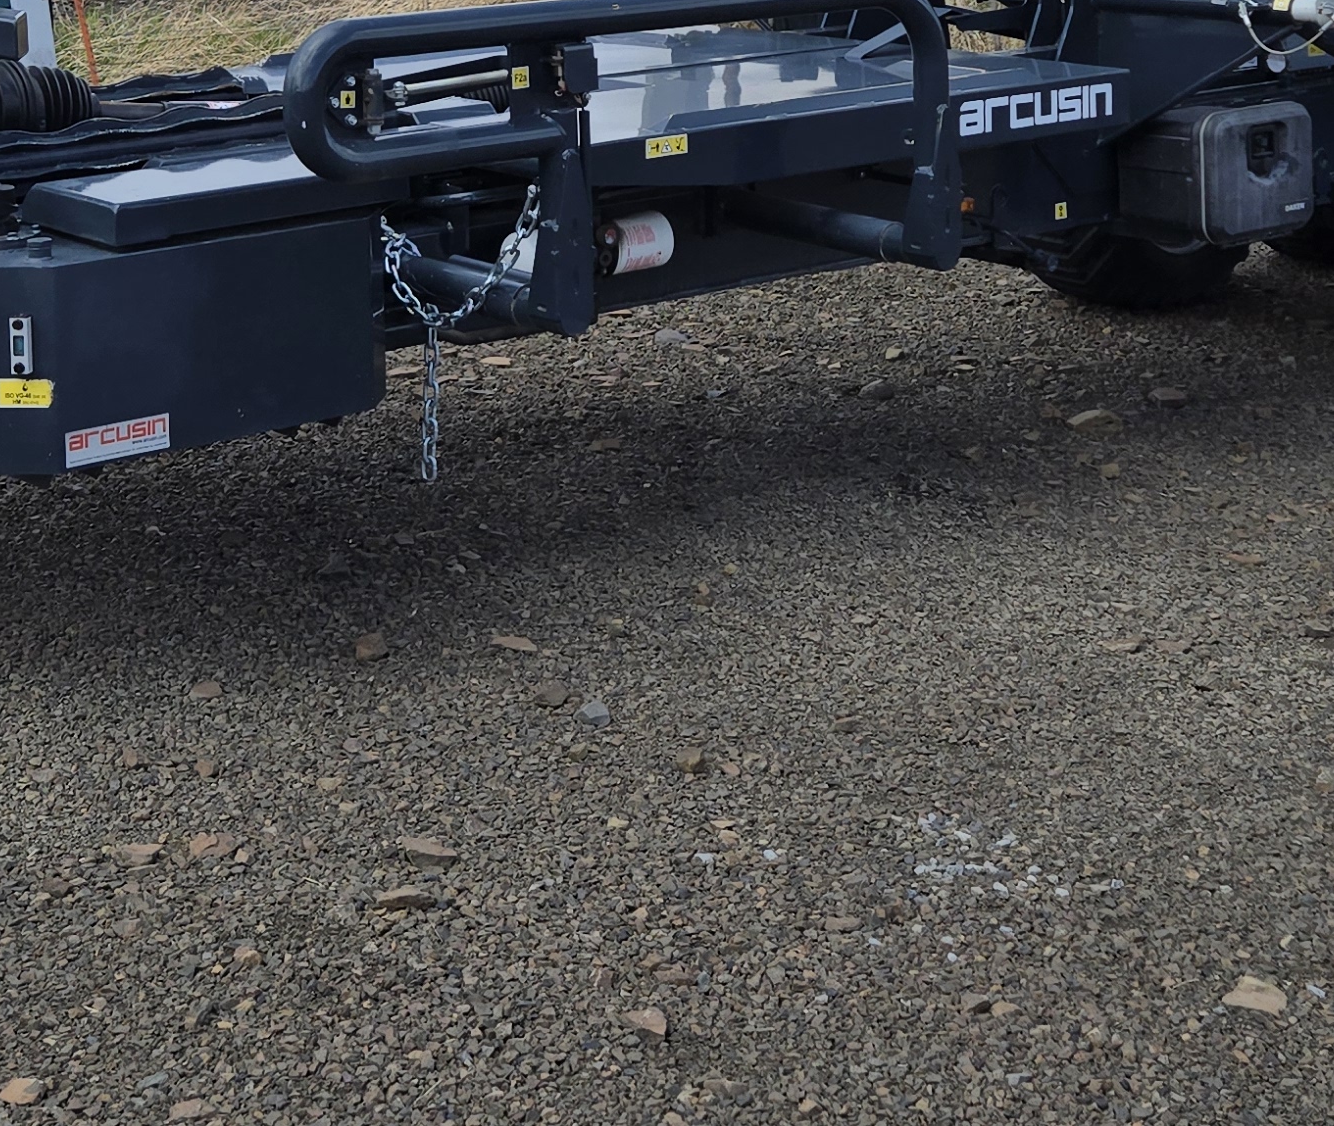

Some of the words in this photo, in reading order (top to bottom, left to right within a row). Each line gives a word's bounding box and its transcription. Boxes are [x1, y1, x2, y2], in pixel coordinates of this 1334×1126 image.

[514, 72, 527, 83] F2a
[959, 82, 1113, 137] arcusin
[69, 417, 166, 452] arcusin
